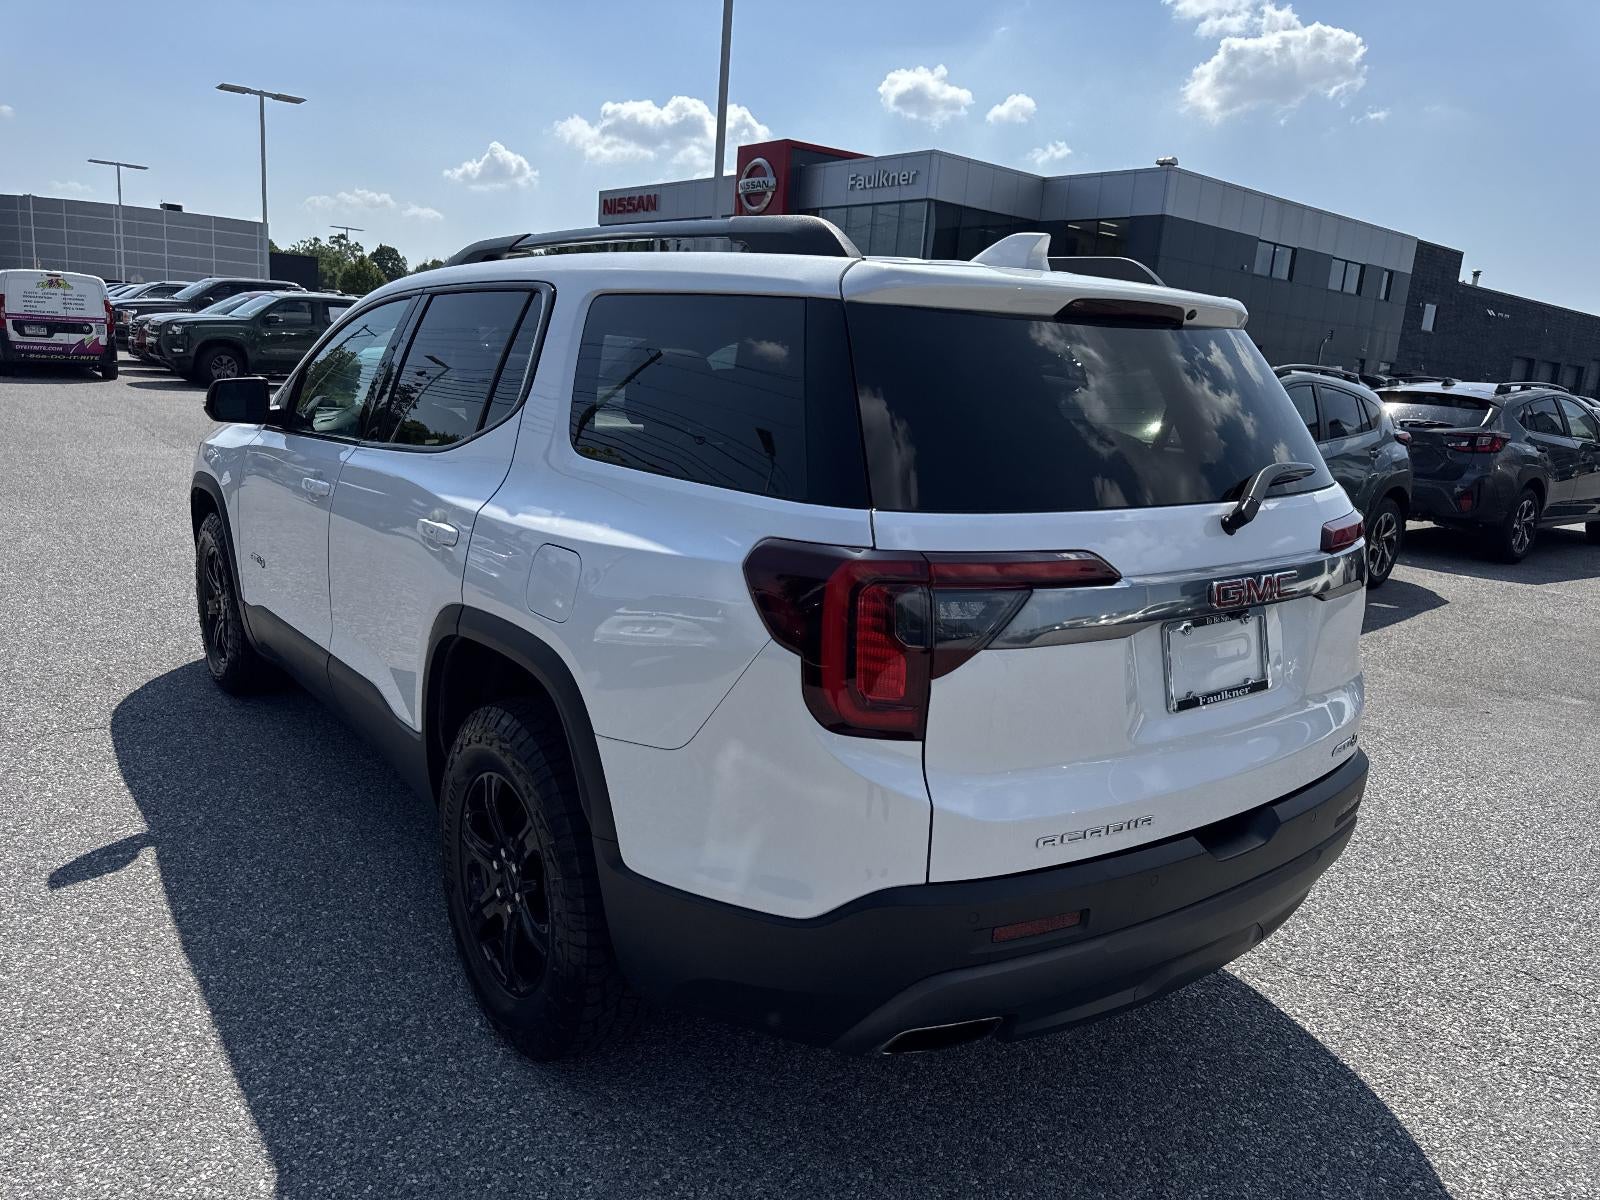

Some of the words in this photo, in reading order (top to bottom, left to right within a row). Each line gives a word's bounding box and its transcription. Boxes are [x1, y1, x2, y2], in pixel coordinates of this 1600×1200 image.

[739, 180, 769, 190] NISSAN
[848, 169, 918, 190] Faulkner
[602, 193, 659, 216] NISSAN
[1212, 570, 1298, 609] GMC
[1199, 686, 1251, 706] Faulkner
[1036, 815, 1154, 849] ACADIA
